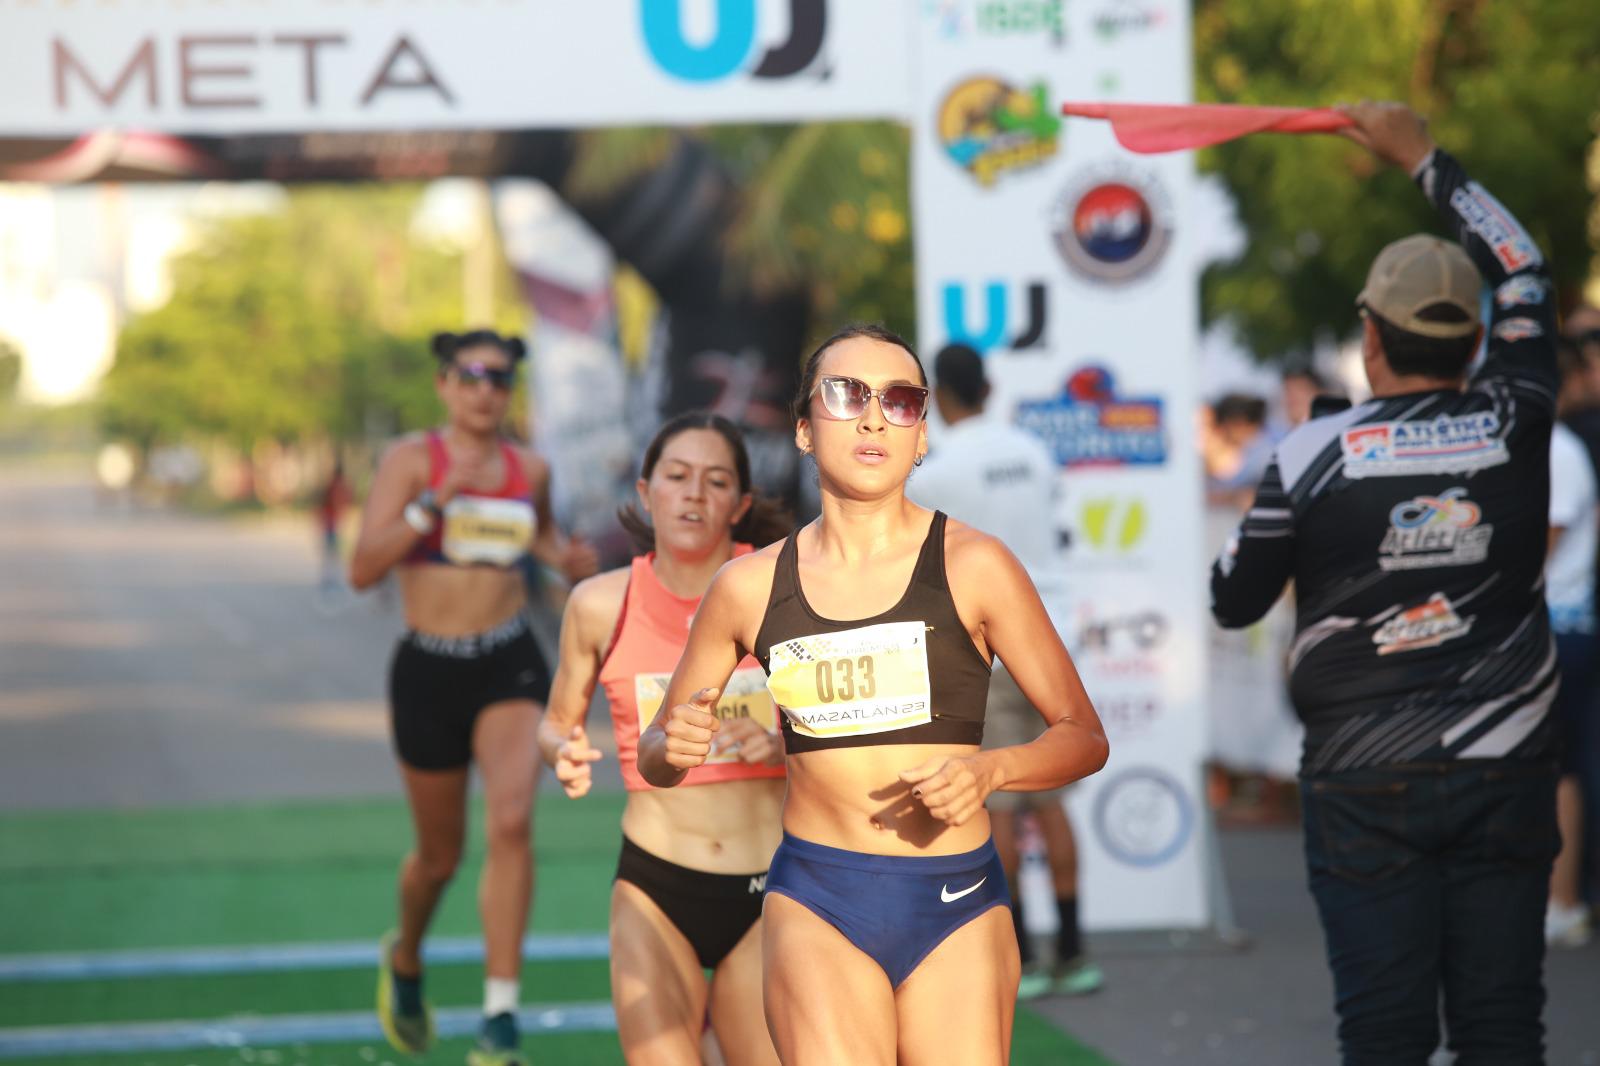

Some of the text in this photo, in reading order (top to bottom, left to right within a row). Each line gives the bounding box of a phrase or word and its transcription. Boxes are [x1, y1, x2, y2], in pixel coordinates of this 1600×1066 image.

[52, 34, 457, 108] META
[815, 655, 877, 703] 033
[901, 701, 925, 714] 23
